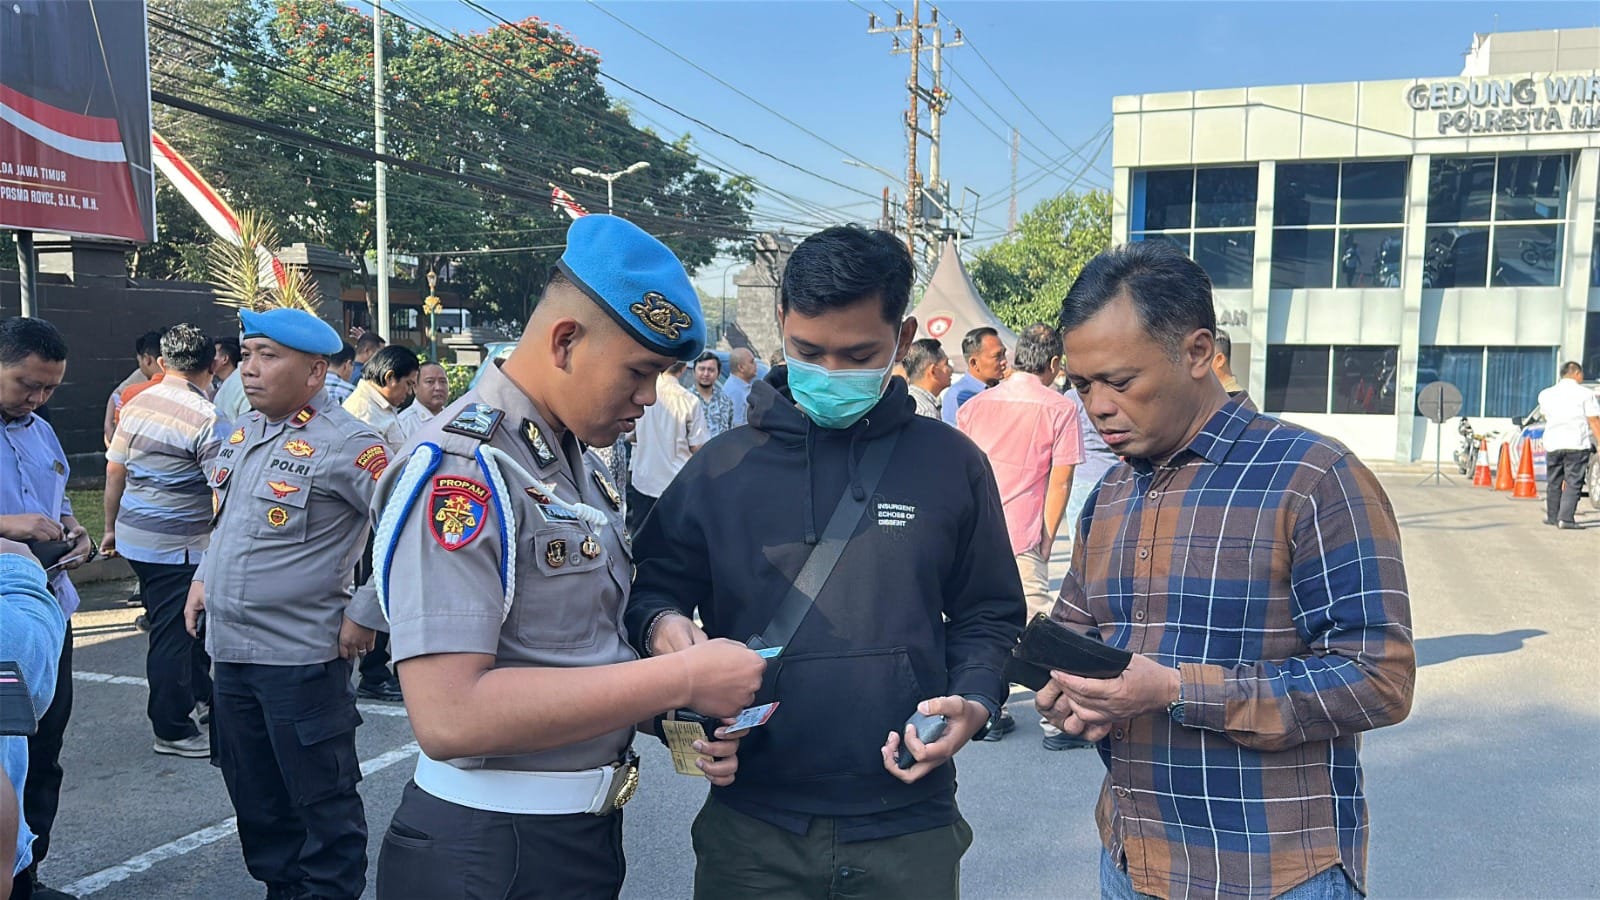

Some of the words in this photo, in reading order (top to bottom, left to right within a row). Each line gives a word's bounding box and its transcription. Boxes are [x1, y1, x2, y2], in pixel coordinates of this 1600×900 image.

[1408, 78, 1537, 110] GEDUNG
[1438, 107, 1563, 134] POLRESTA
[0, 162, 13, 174] DA
[16, 164, 39, 178] JAWA
[40, 167, 67, 182] TIMUR
[0, 186, 29, 202] PASMA
[31, 190, 57, 207] ROYCE,
[82, 197, 99, 210] M.H.
[270, 459, 310, 476] POLRI
[439, 479, 486, 497] PROPAM
[877, 503, 916, 512] INSURGENT
